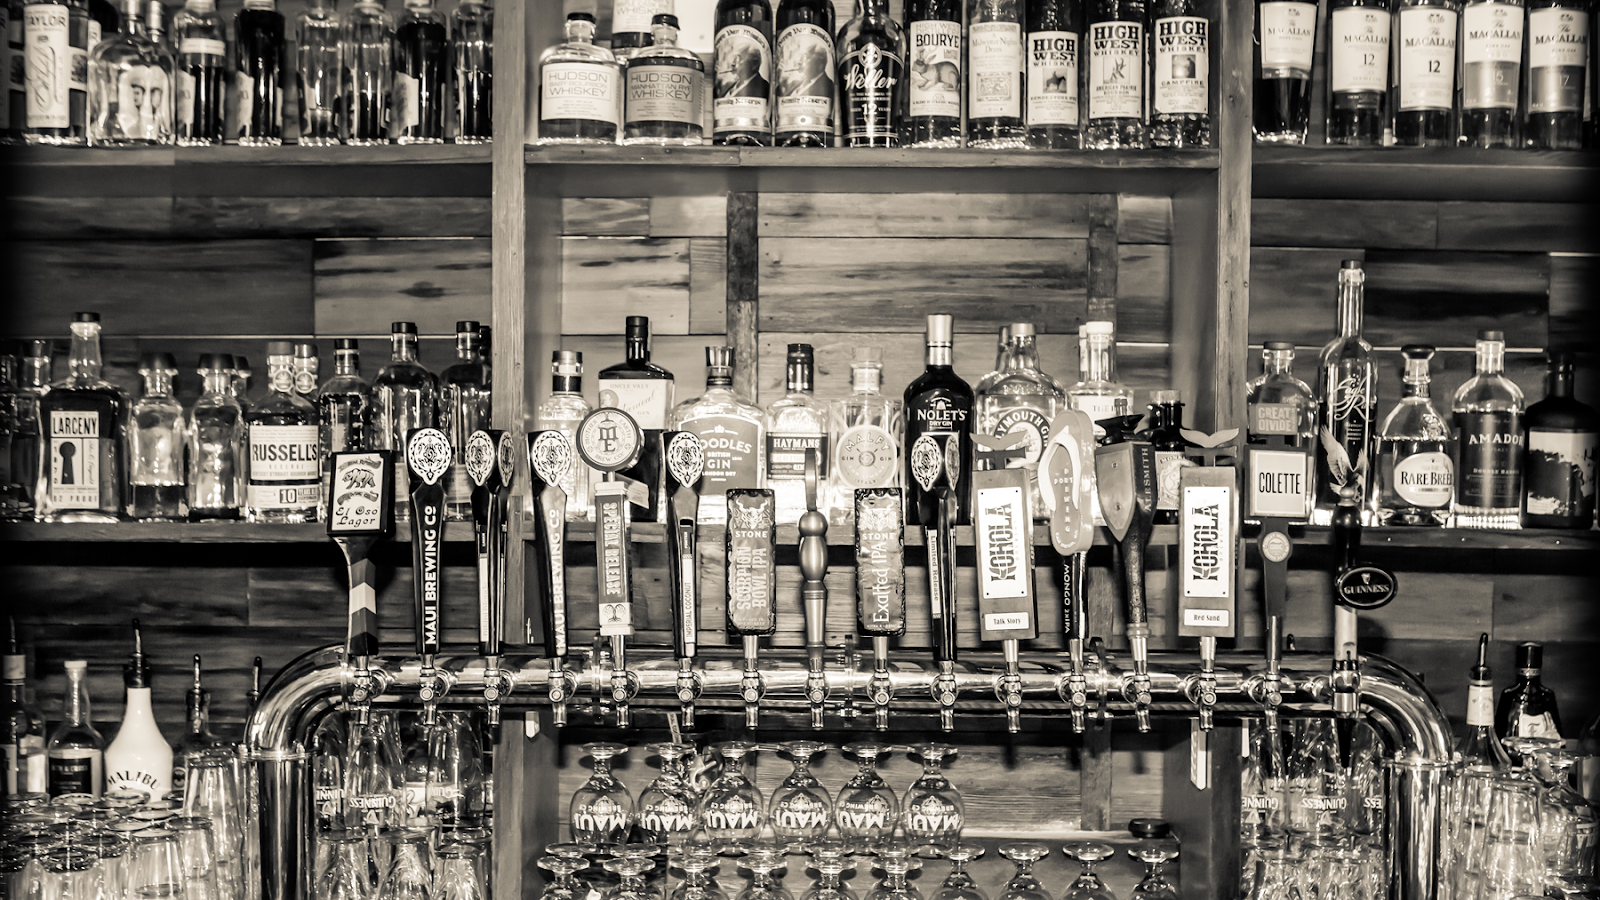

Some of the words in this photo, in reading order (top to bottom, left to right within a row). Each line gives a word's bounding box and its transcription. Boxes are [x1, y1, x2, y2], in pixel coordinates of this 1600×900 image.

[1094, 25, 1139, 40] HIGH
[1160, 20, 1206, 36] HIGH
[1469, 30, 1520, 40] MACALLAN
[916, 34, 960, 48] BOURYE
[1033, 38, 1075, 51] HIGH
[1094, 40, 1139, 50] WEST
[1160, 36, 1206, 46] WEST
[1344, 34, 1388, 44] MACALLAN
[1405, 38, 1454, 48] MACALLAN
[1535, 34, 1587, 44] MACALLAN
[1034, 52, 1076, 61] WEST
[1364, 53, 1375, 66] 12
[1428, 60, 1441, 72] 12
[549, 72, 608, 83] HUDSON
[631, 73, 692, 84] HUDSON
[844, 64, 898, 91] Weller
[549, 87, 606, 97] WHISKEY
[632, 89, 690, 99] WHISKEY
[862, 104, 878, 114] 12
[917, 408, 966, 421] NOLET'S
[1258, 406, 1291, 420] GREAT
[53, 417, 97, 434] LARCENY
[994, 411, 1044, 439] LYMOUTH
[1258, 420, 1292, 432] DIVIDE
[700, 438, 752, 454] OODLES
[845, 432, 890, 452] MALFY
[252, 444, 318, 462] RUSSELL'S
[706, 459, 730, 469] GIN
[1259, 472, 1301, 494] COLETTE
[1400, 471, 1429, 486] RARE
[280, 489, 296, 504] 10
[336, 506, 350, 516] El
[355, 506, 378, 516] Oso
[336, 516, 376, 528] Lager
[602, 502, 621, 548] SPECIAL
[752, 547, 766, 569] IPA
[870, 542, 887, 564] IPA
[425, 529, 437, 602] BREWING
[550, 532, 564, 604] BREWING
[605, 548, 620, 595] RELEASE
[736, 546, 752, 610] SCORPION
[752, 572, 767, 608] BOWL
[872, 568, 890, 622] Exalted
[1343, 584, 1390, 594] GUINNESS
[425, 608, 437, 645] MAUI
[554, 608, 566, 648] MAUI
[108, 770, 160, 790] MALIBU
[349, 796, 396, 808] GUINNESS
[1242, 797, 1278, 810] GUINNE
[1300, 798, 1347, 810] GUINNESS
[574, 813, 626, 831] MAUI
[641, 813, 692, 831] MAUI
[706, 810, 758, 828] MAUI
[776, 810, 827, 828] MAUI
[838, 811, 884, 829] MAU
[908, 814, 959, 831] MAUI
